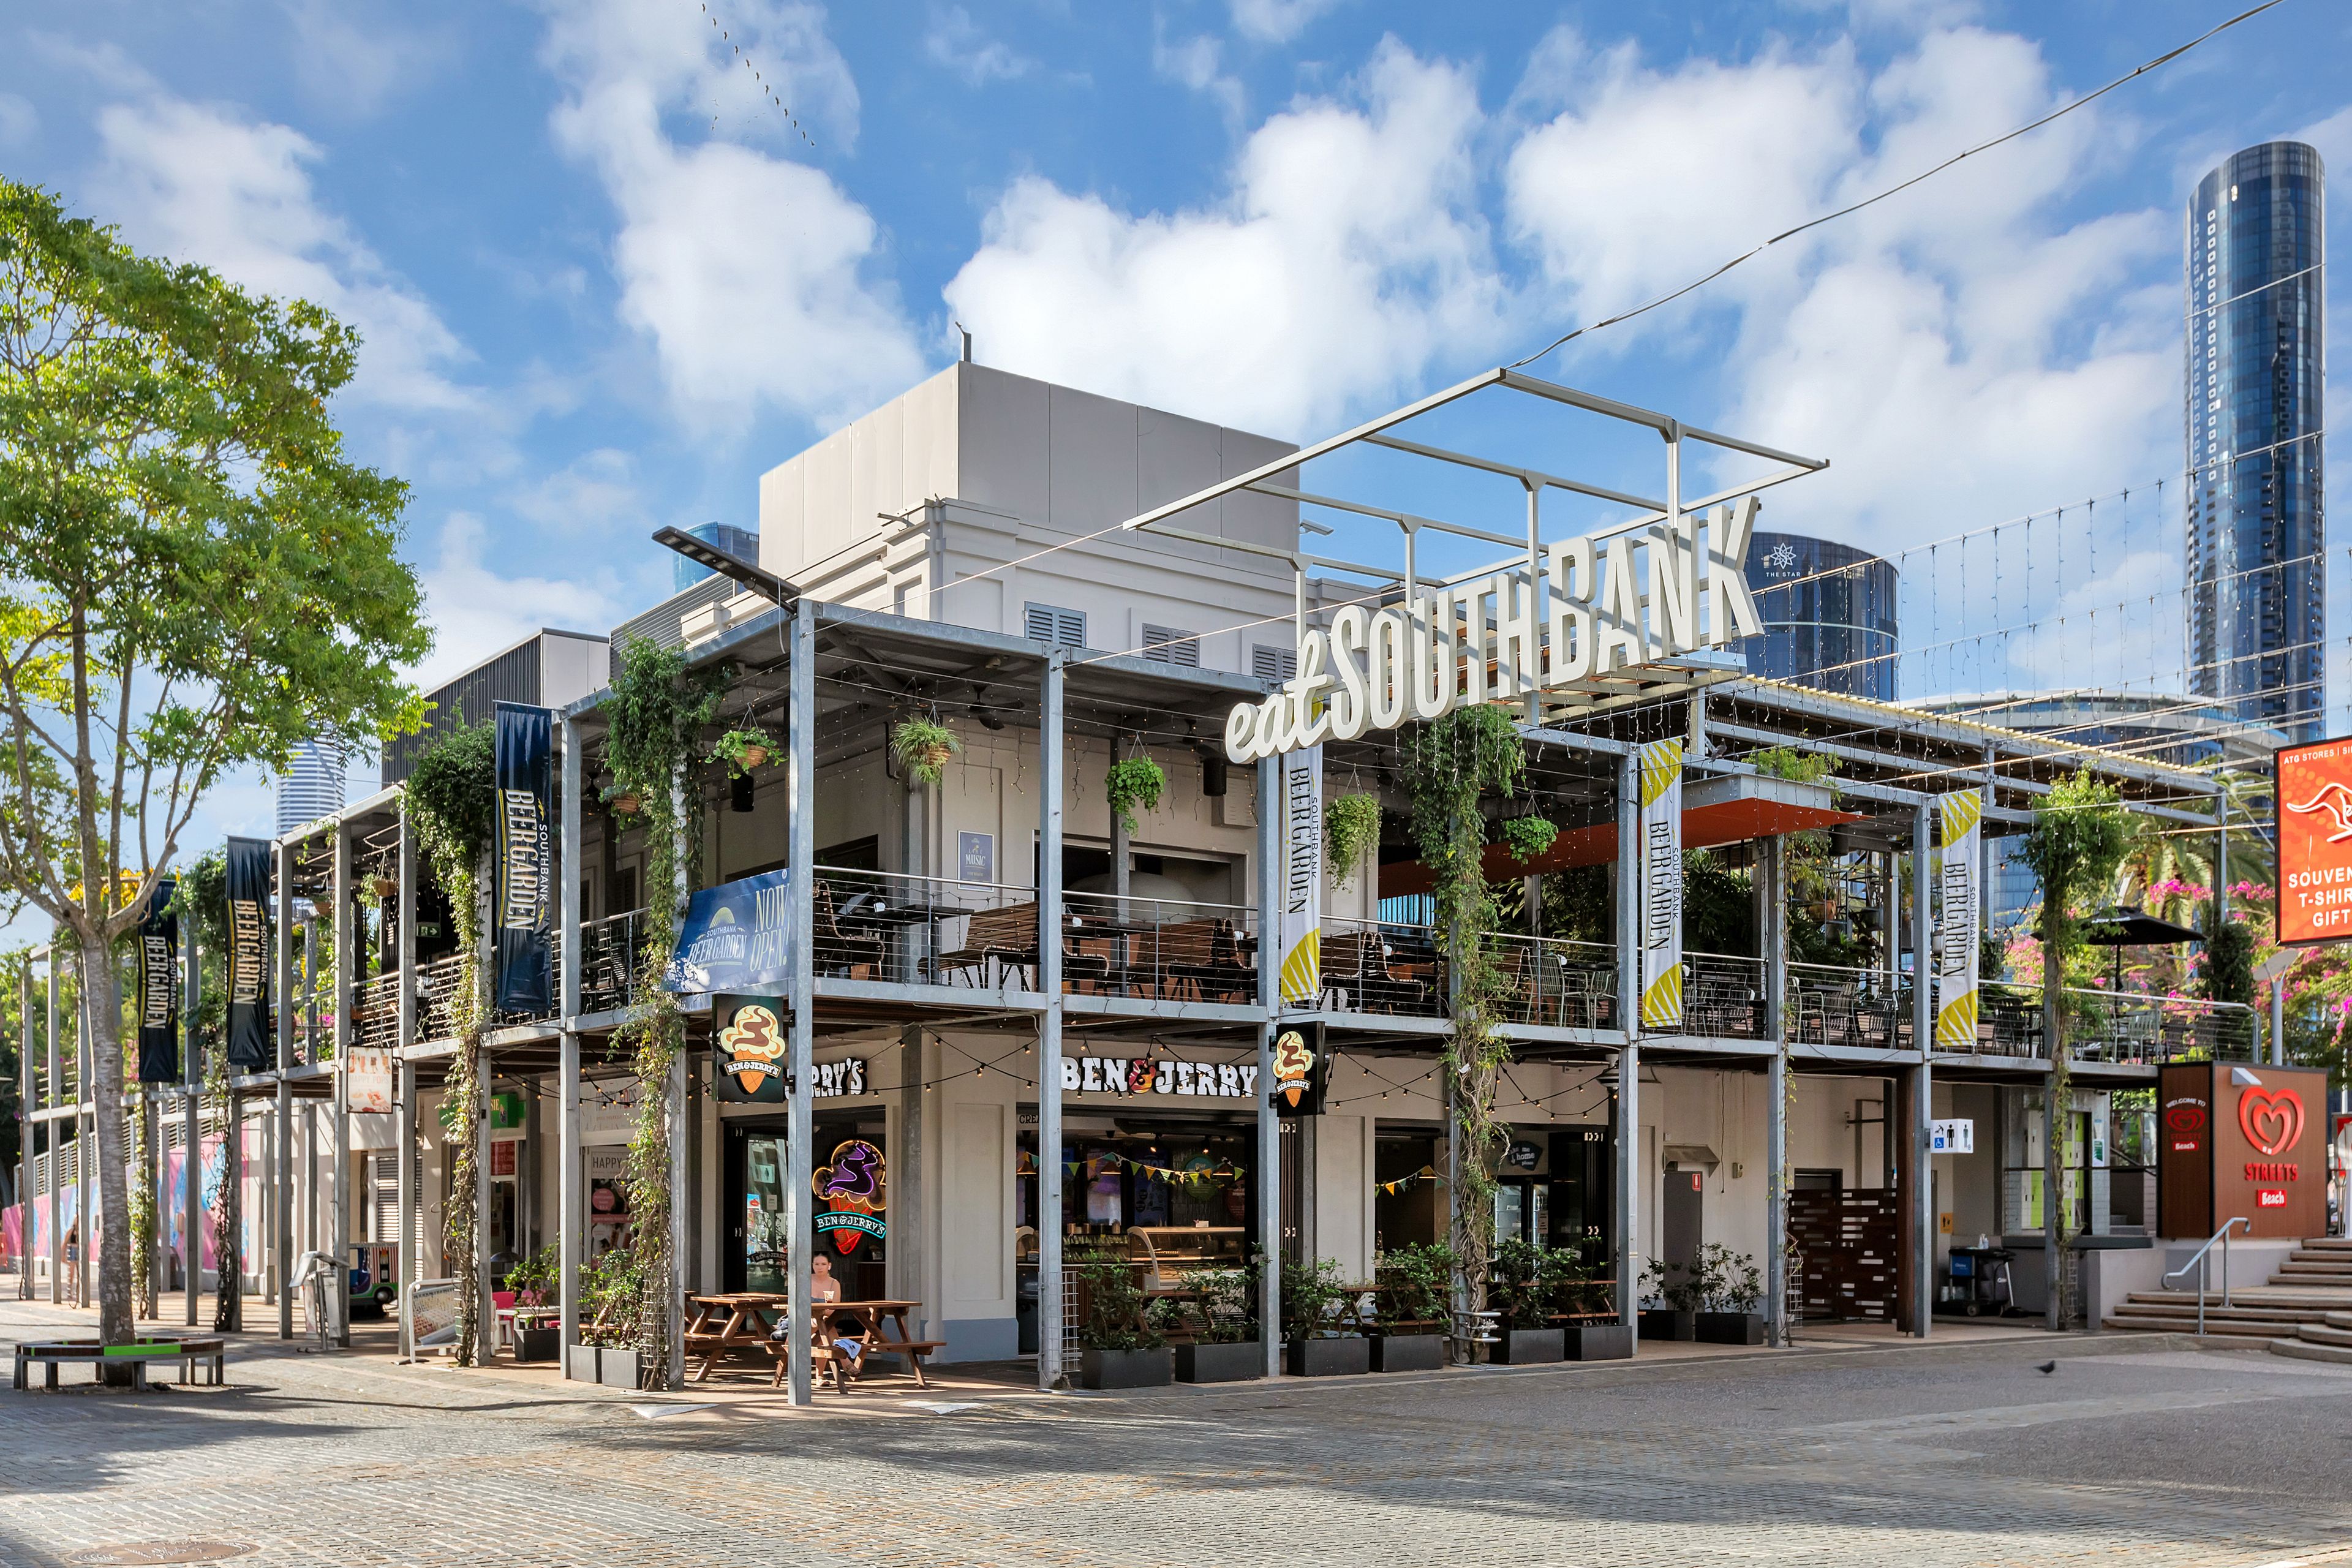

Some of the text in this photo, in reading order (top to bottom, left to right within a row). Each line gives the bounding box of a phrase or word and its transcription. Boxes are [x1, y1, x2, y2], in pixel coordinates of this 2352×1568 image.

[2283, 745, 2352, 764] ATG STORES SI
[1288, 766, 1311, 914] BEER GARDEN
[505, 788, 538, 931] BEER GARDEN
[539, 823, 549, 902] SOUTHBANK
[965, 854, 986, 866] MUSIC
[1649, 820, 1672, 950] BEER GARDEN
[755, 883, 790, 932] NOW
[1943, 863, 1969, 977] BEER GARDEN
[2313, 908, 2350, 927] GIFT
[706, 925, 736, 938] SOUTHBANK
[233, 899, 260, 1005] BEER GARDEN
[688, 935, 747, 963] BEER GARDEN
[145, 935, 169, 1029] BEER GARDEN
[2165, 1098, 2196, 1108] WELCOME
[592, 1156, 622, 1169] HAPPY
[2245, 1162, 2299, 1182] STREETS
[2261, 1190, 2285, 1205] Beach
